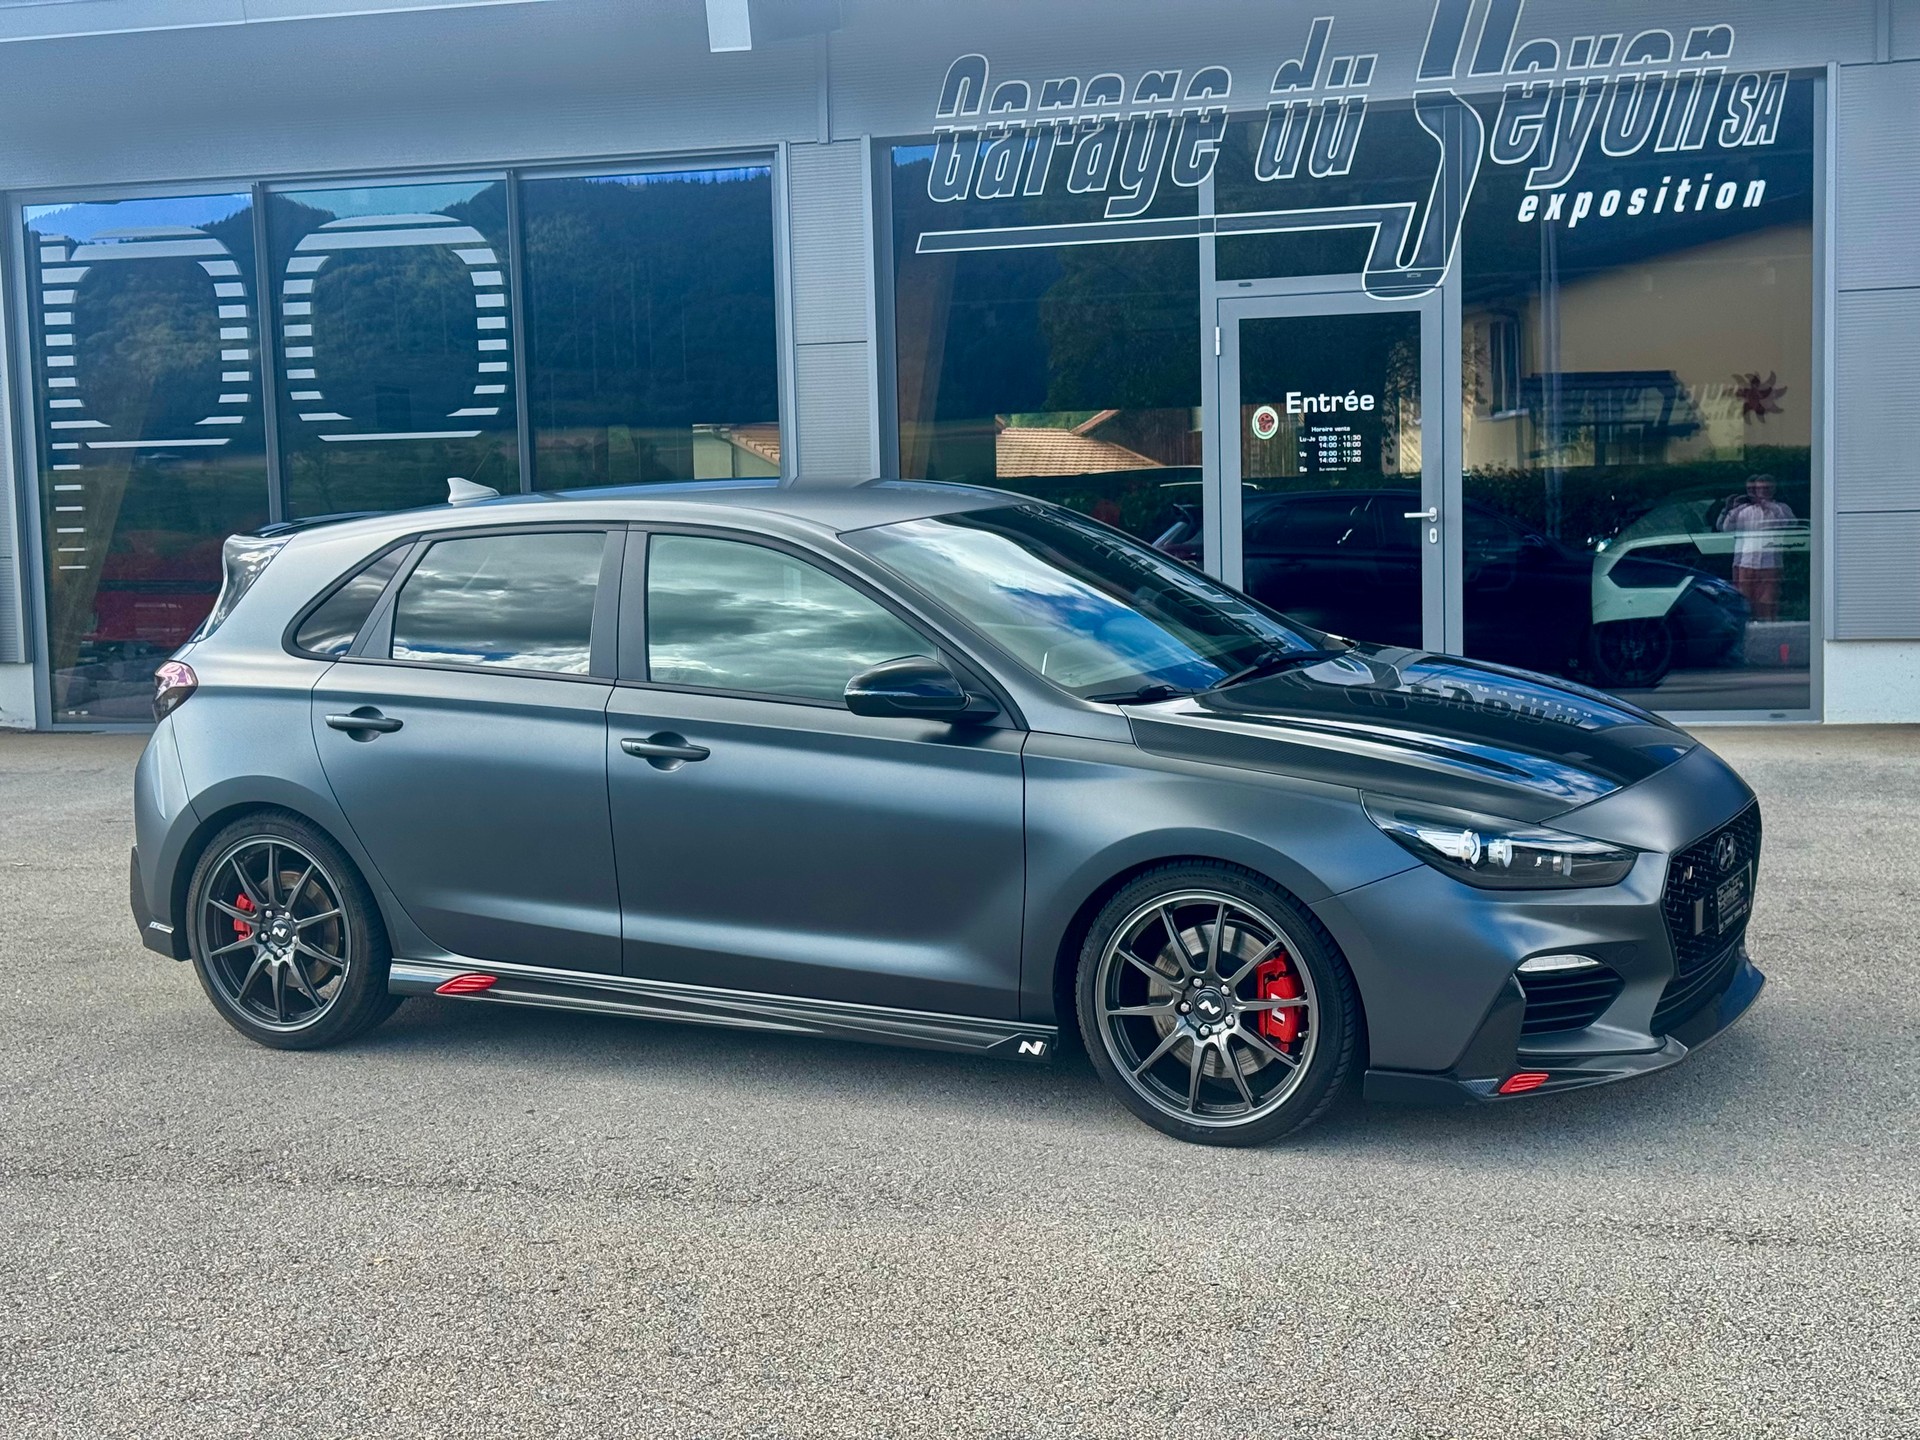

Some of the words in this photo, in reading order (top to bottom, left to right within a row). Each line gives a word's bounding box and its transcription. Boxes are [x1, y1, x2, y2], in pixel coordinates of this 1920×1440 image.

[928, 54, 1232, 218] Garage
[1255, 16, 1378, 181] du
[1718, 71, 1790, 148] SA
[1517, 172, 1767, 228] exposition
[1286, 390, 1375, 414] Entrée
[1018, 1040, 1048, 1056] N
